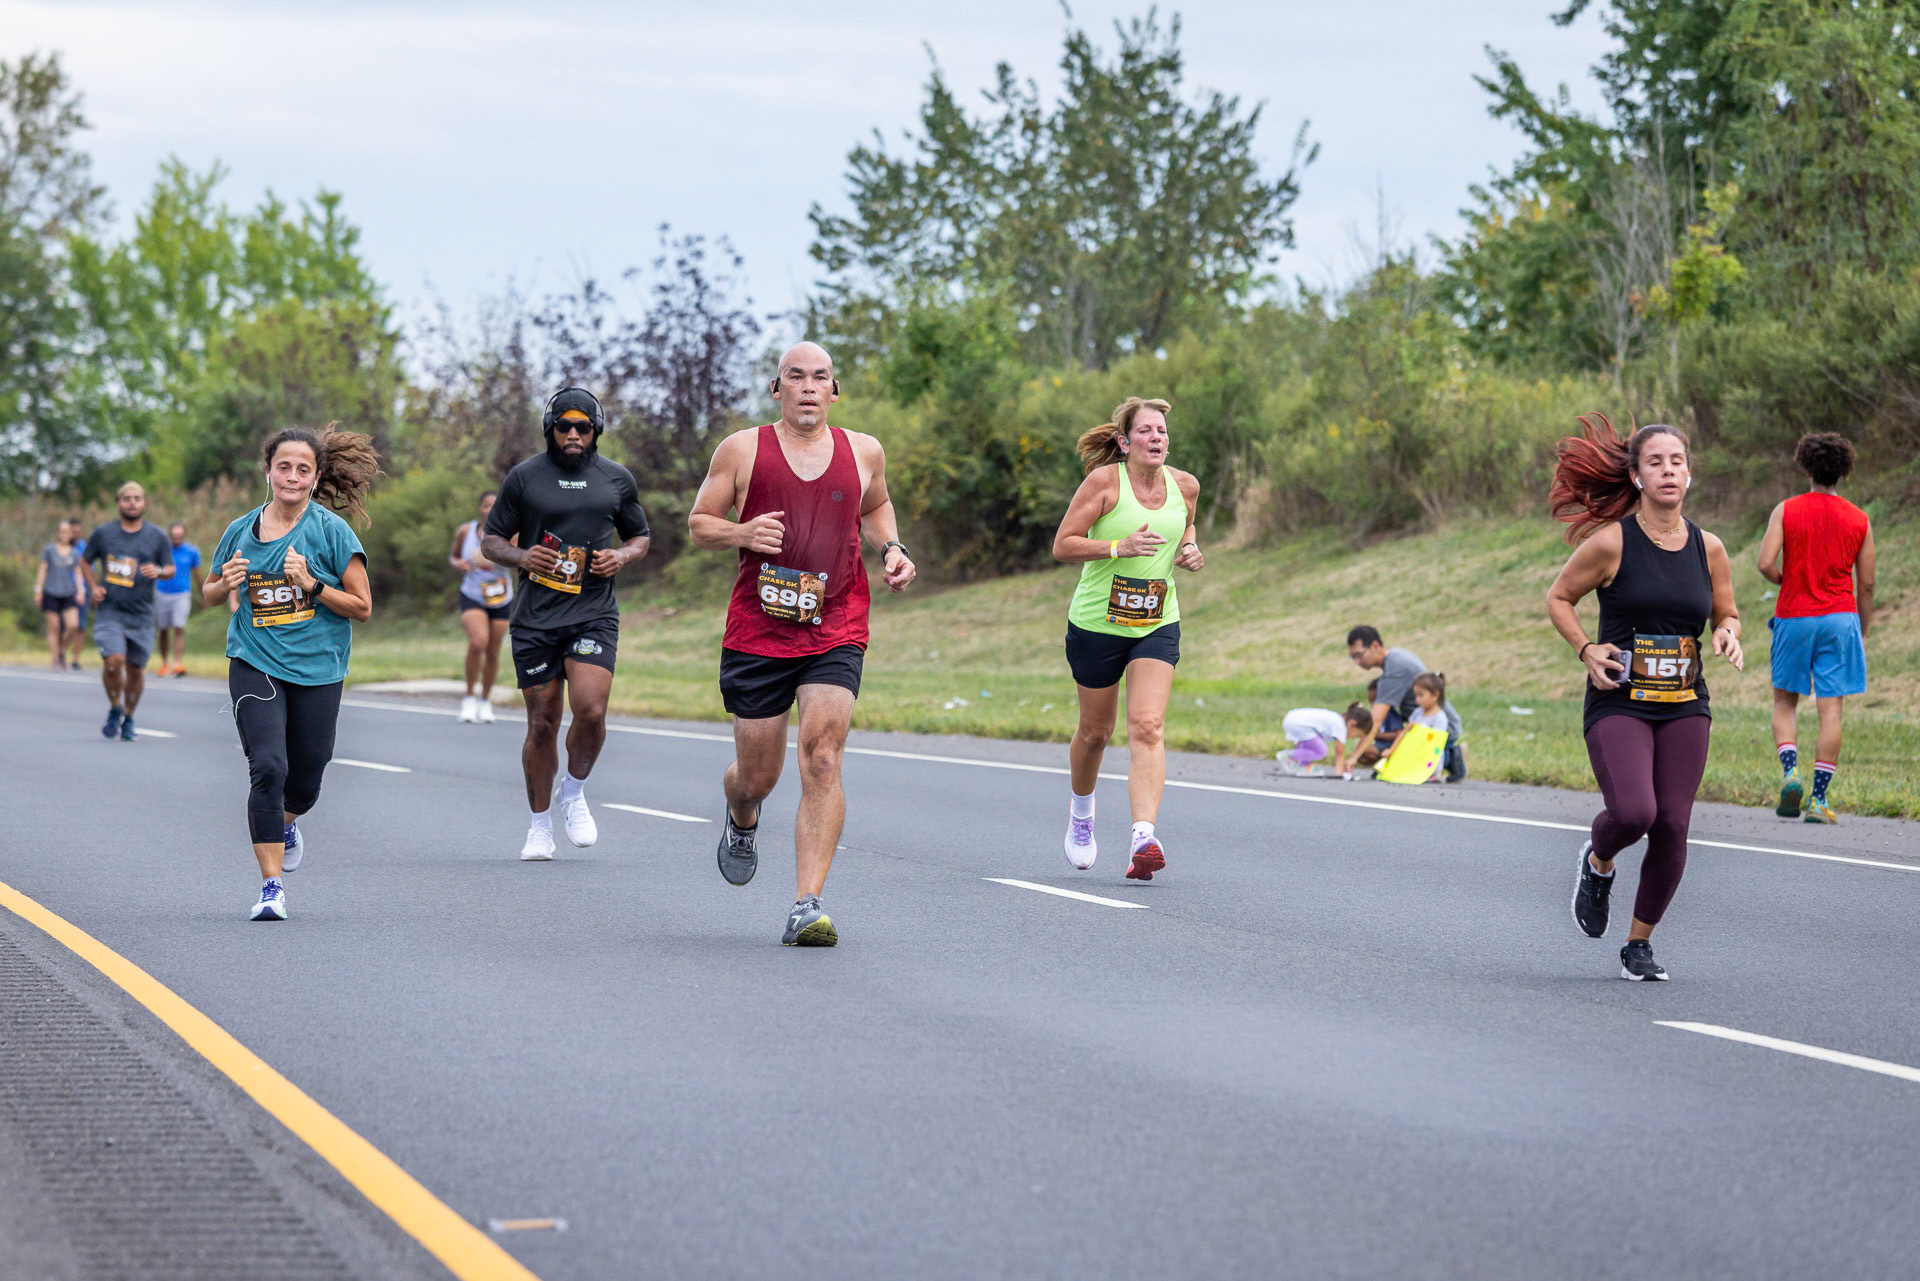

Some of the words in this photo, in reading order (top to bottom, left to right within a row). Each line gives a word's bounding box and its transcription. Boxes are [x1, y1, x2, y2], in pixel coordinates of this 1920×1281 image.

[759, 575, 786, 586] CHASE
[257, 585, 303, 605] 361
[760, 584, 818, 610] 696
[1117, 592, 1159, 609] 138
[1644, 657, 1691, 677] 157
